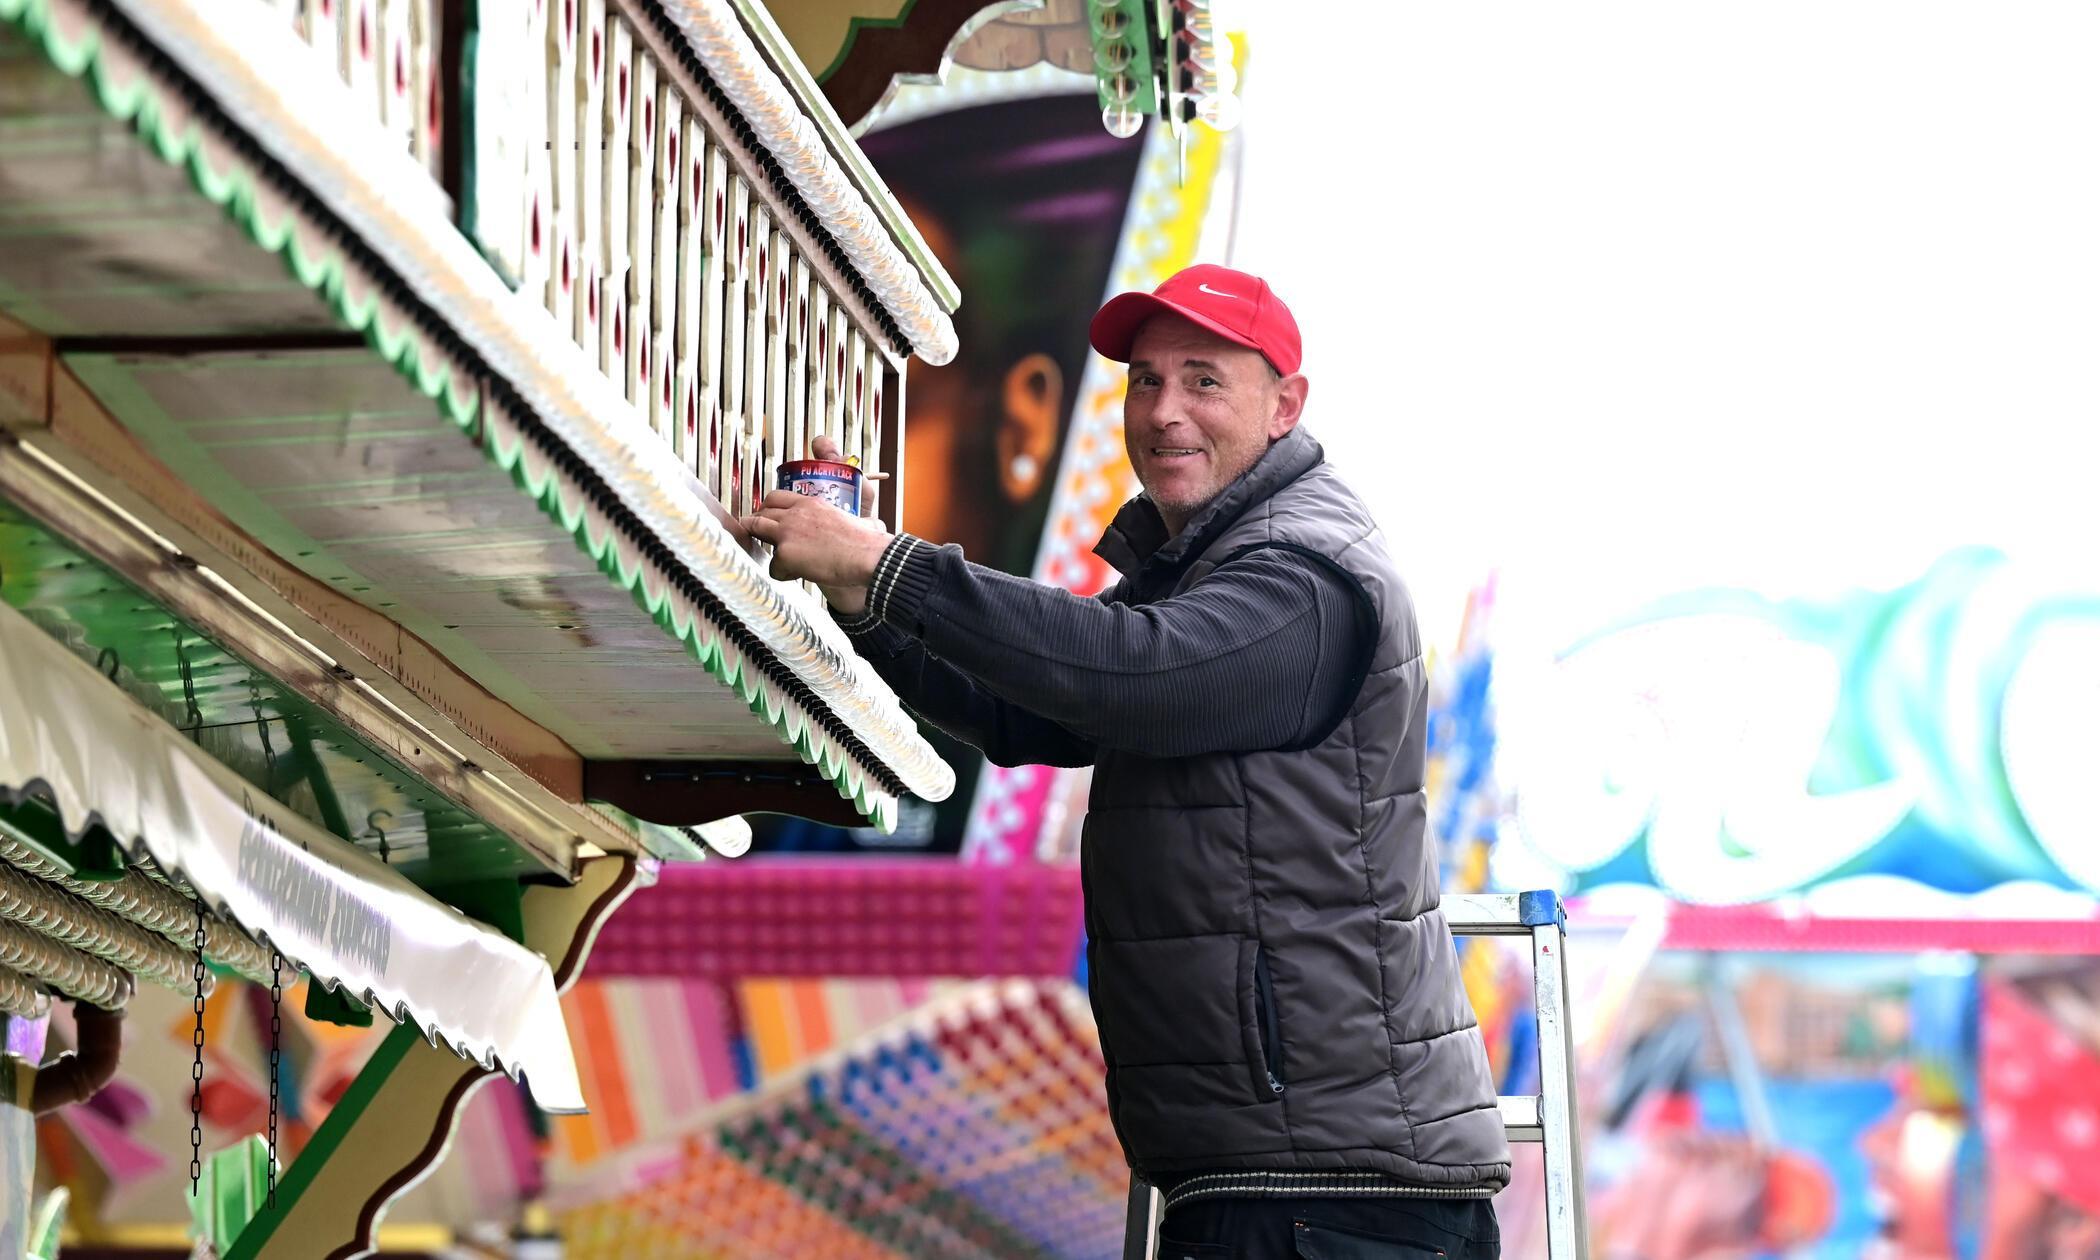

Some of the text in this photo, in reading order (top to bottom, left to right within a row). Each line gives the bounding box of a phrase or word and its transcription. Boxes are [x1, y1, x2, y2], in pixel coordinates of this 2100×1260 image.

[801, 467, 853, 480] PU ACRYL LACK
